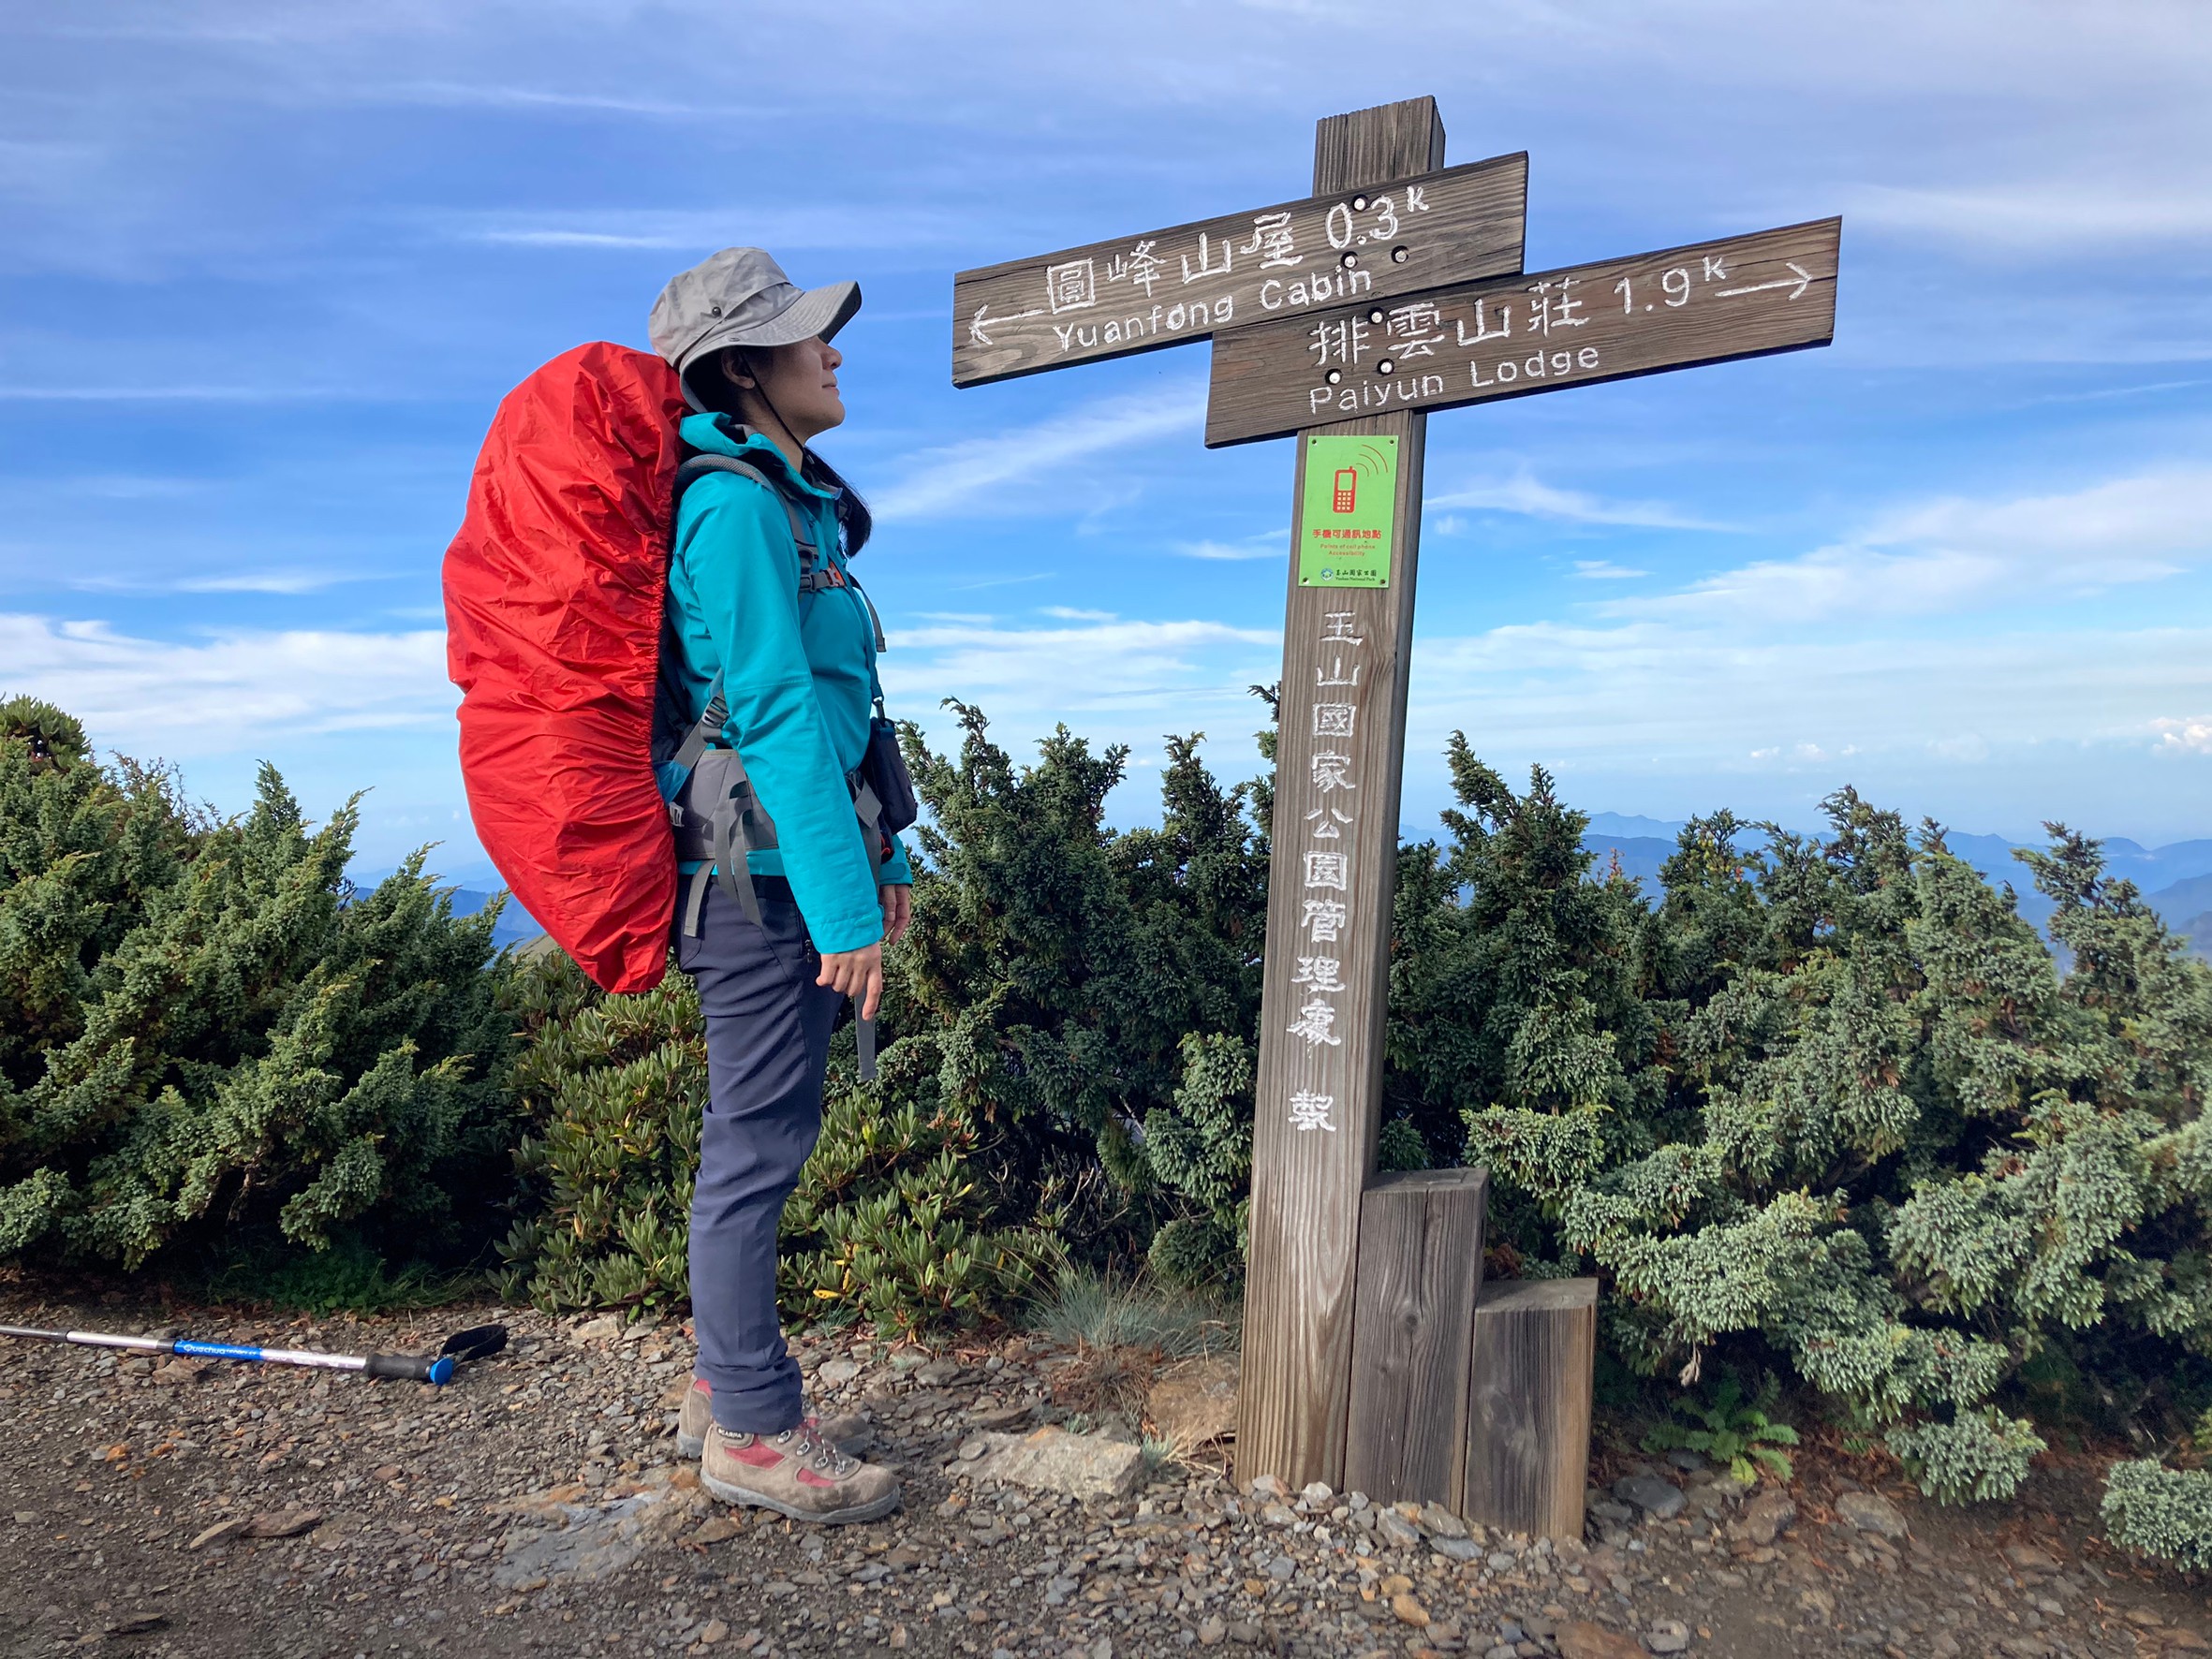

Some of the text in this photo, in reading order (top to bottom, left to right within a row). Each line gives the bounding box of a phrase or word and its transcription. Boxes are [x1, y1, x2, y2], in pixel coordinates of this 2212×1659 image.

[1047, 212, 1304, 315] 圓峰山屋
[1053, 264, 1372, 352] Yuanfong Cabin
[1308, 277, 1590, 366] 排雲山莊
[1310, 346, 1600, 416] Paiyun Lodge
[183, 1343, 226, 1355] Quechua
